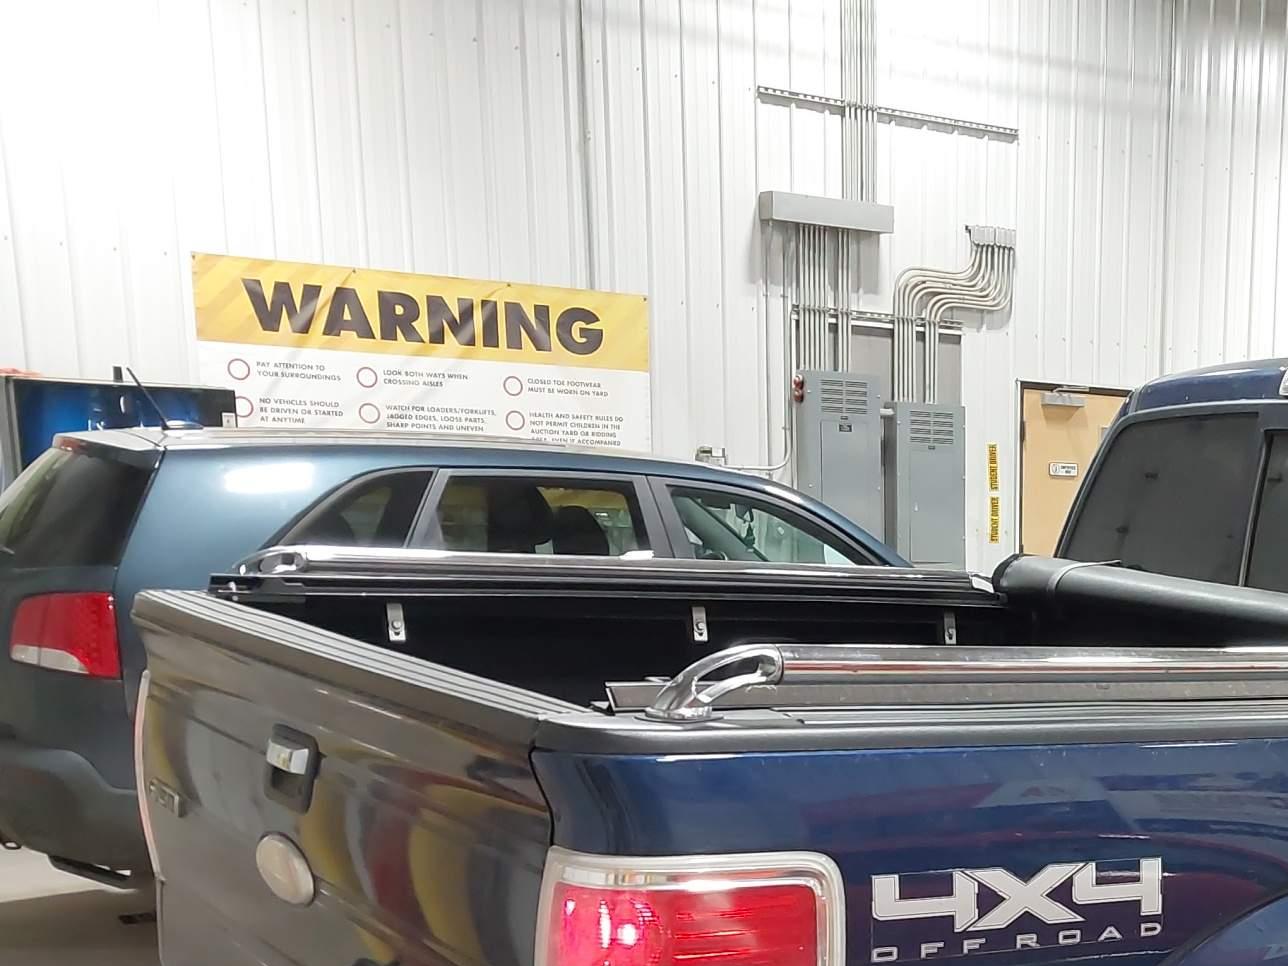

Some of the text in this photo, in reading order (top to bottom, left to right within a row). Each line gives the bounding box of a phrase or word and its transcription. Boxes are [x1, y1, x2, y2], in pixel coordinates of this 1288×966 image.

[241, 278, 604, 356] WARNING
[273, 362, 313, 370] ATTENTION
[280, 371, 342, 381] SURROUNDINGS
[383, 378, 420, 386] CROSSING
[310, 400, 339, 408] SHOULD
[870, 922, 1162, 963] OFF ROAD
